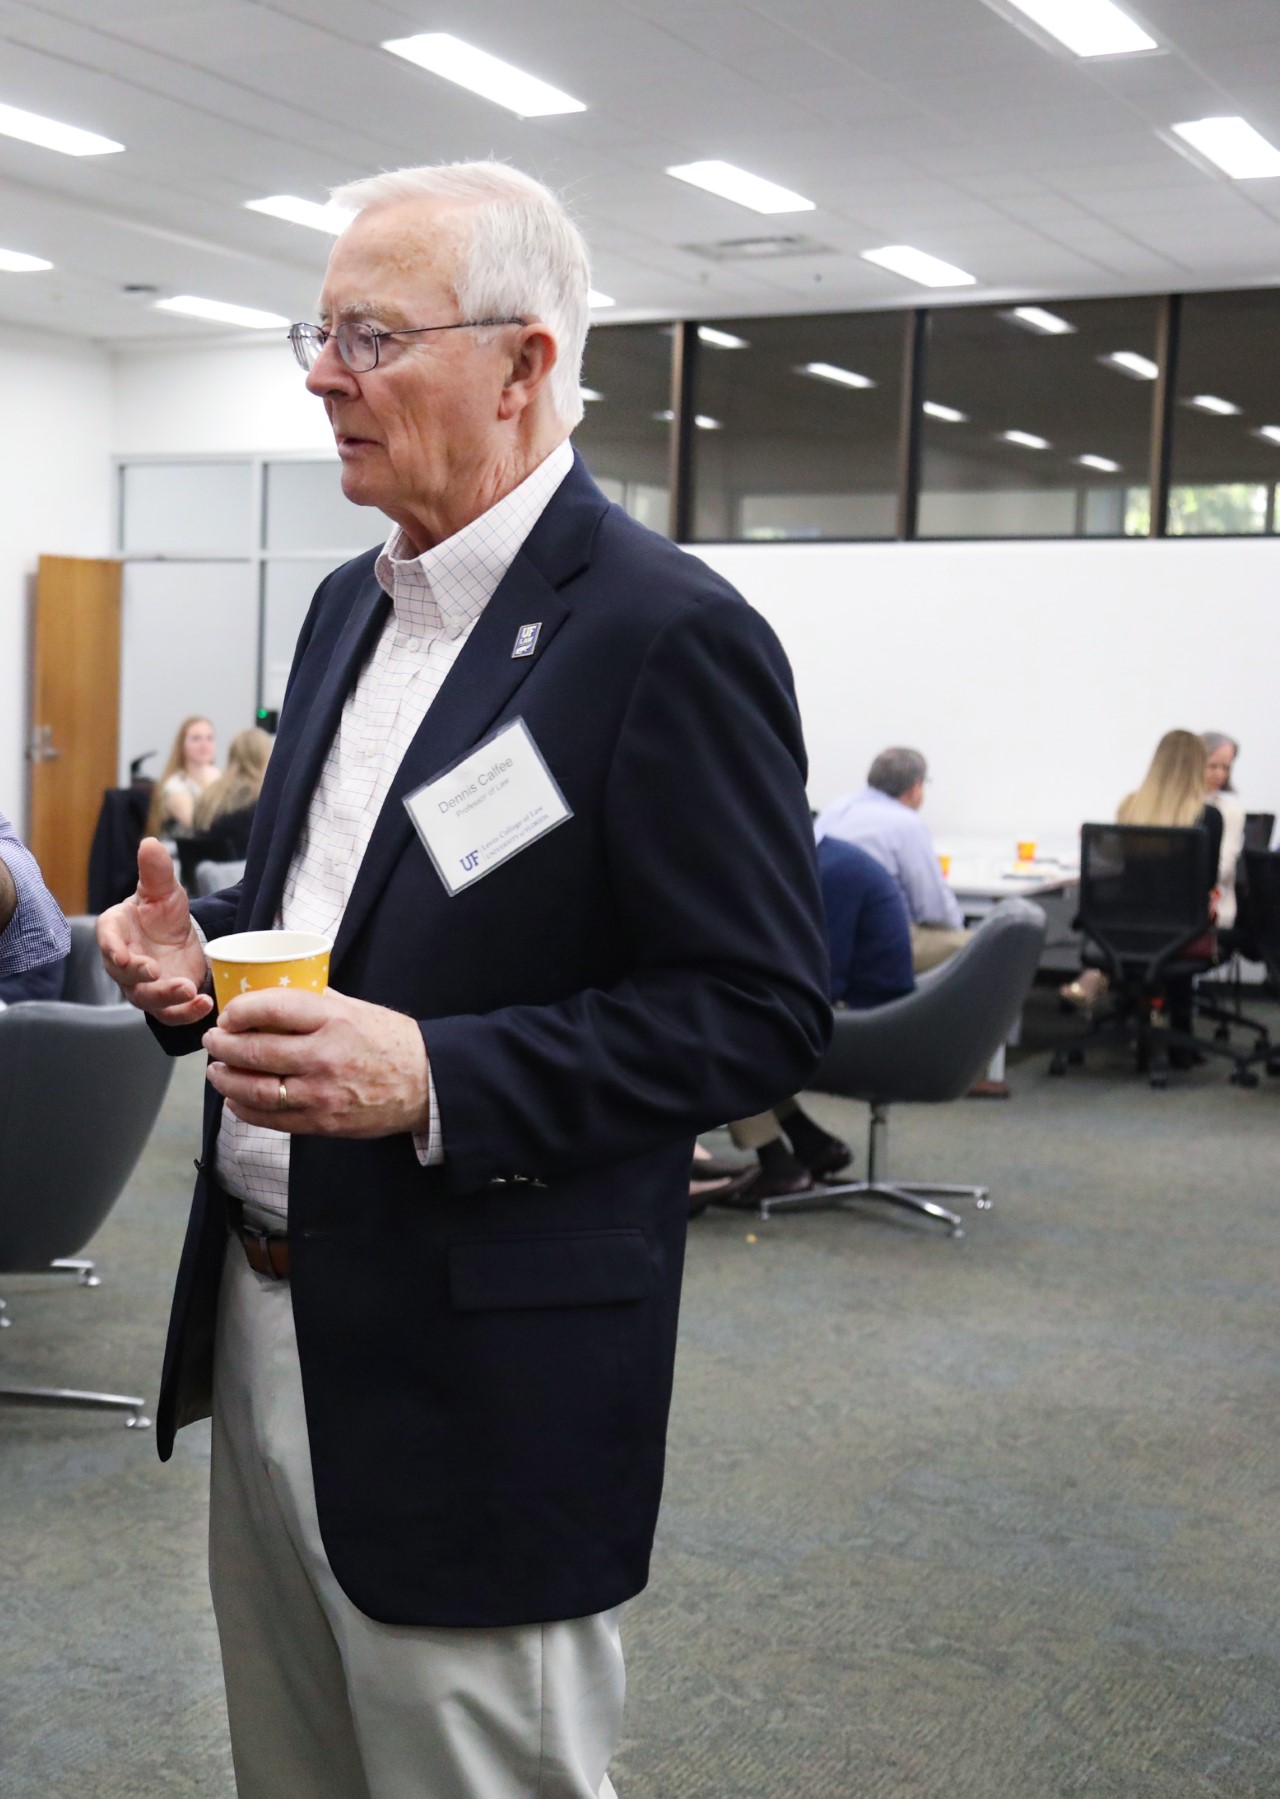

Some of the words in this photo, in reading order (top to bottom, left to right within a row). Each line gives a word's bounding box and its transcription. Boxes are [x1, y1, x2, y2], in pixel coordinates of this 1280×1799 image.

[522, 625, 537, 638] UF
[438, 784, 477, 814] Dennis
[477, 758, 513, 786] Calfee
[456, 794, 487, 817] Professor
[488, 787, 495, 796] of
[496, 778, 509, 790] Law
[500, 821, 522, 838] College
[529, 806, 543, 817] Law
[459, 849, 479, 871] UF
